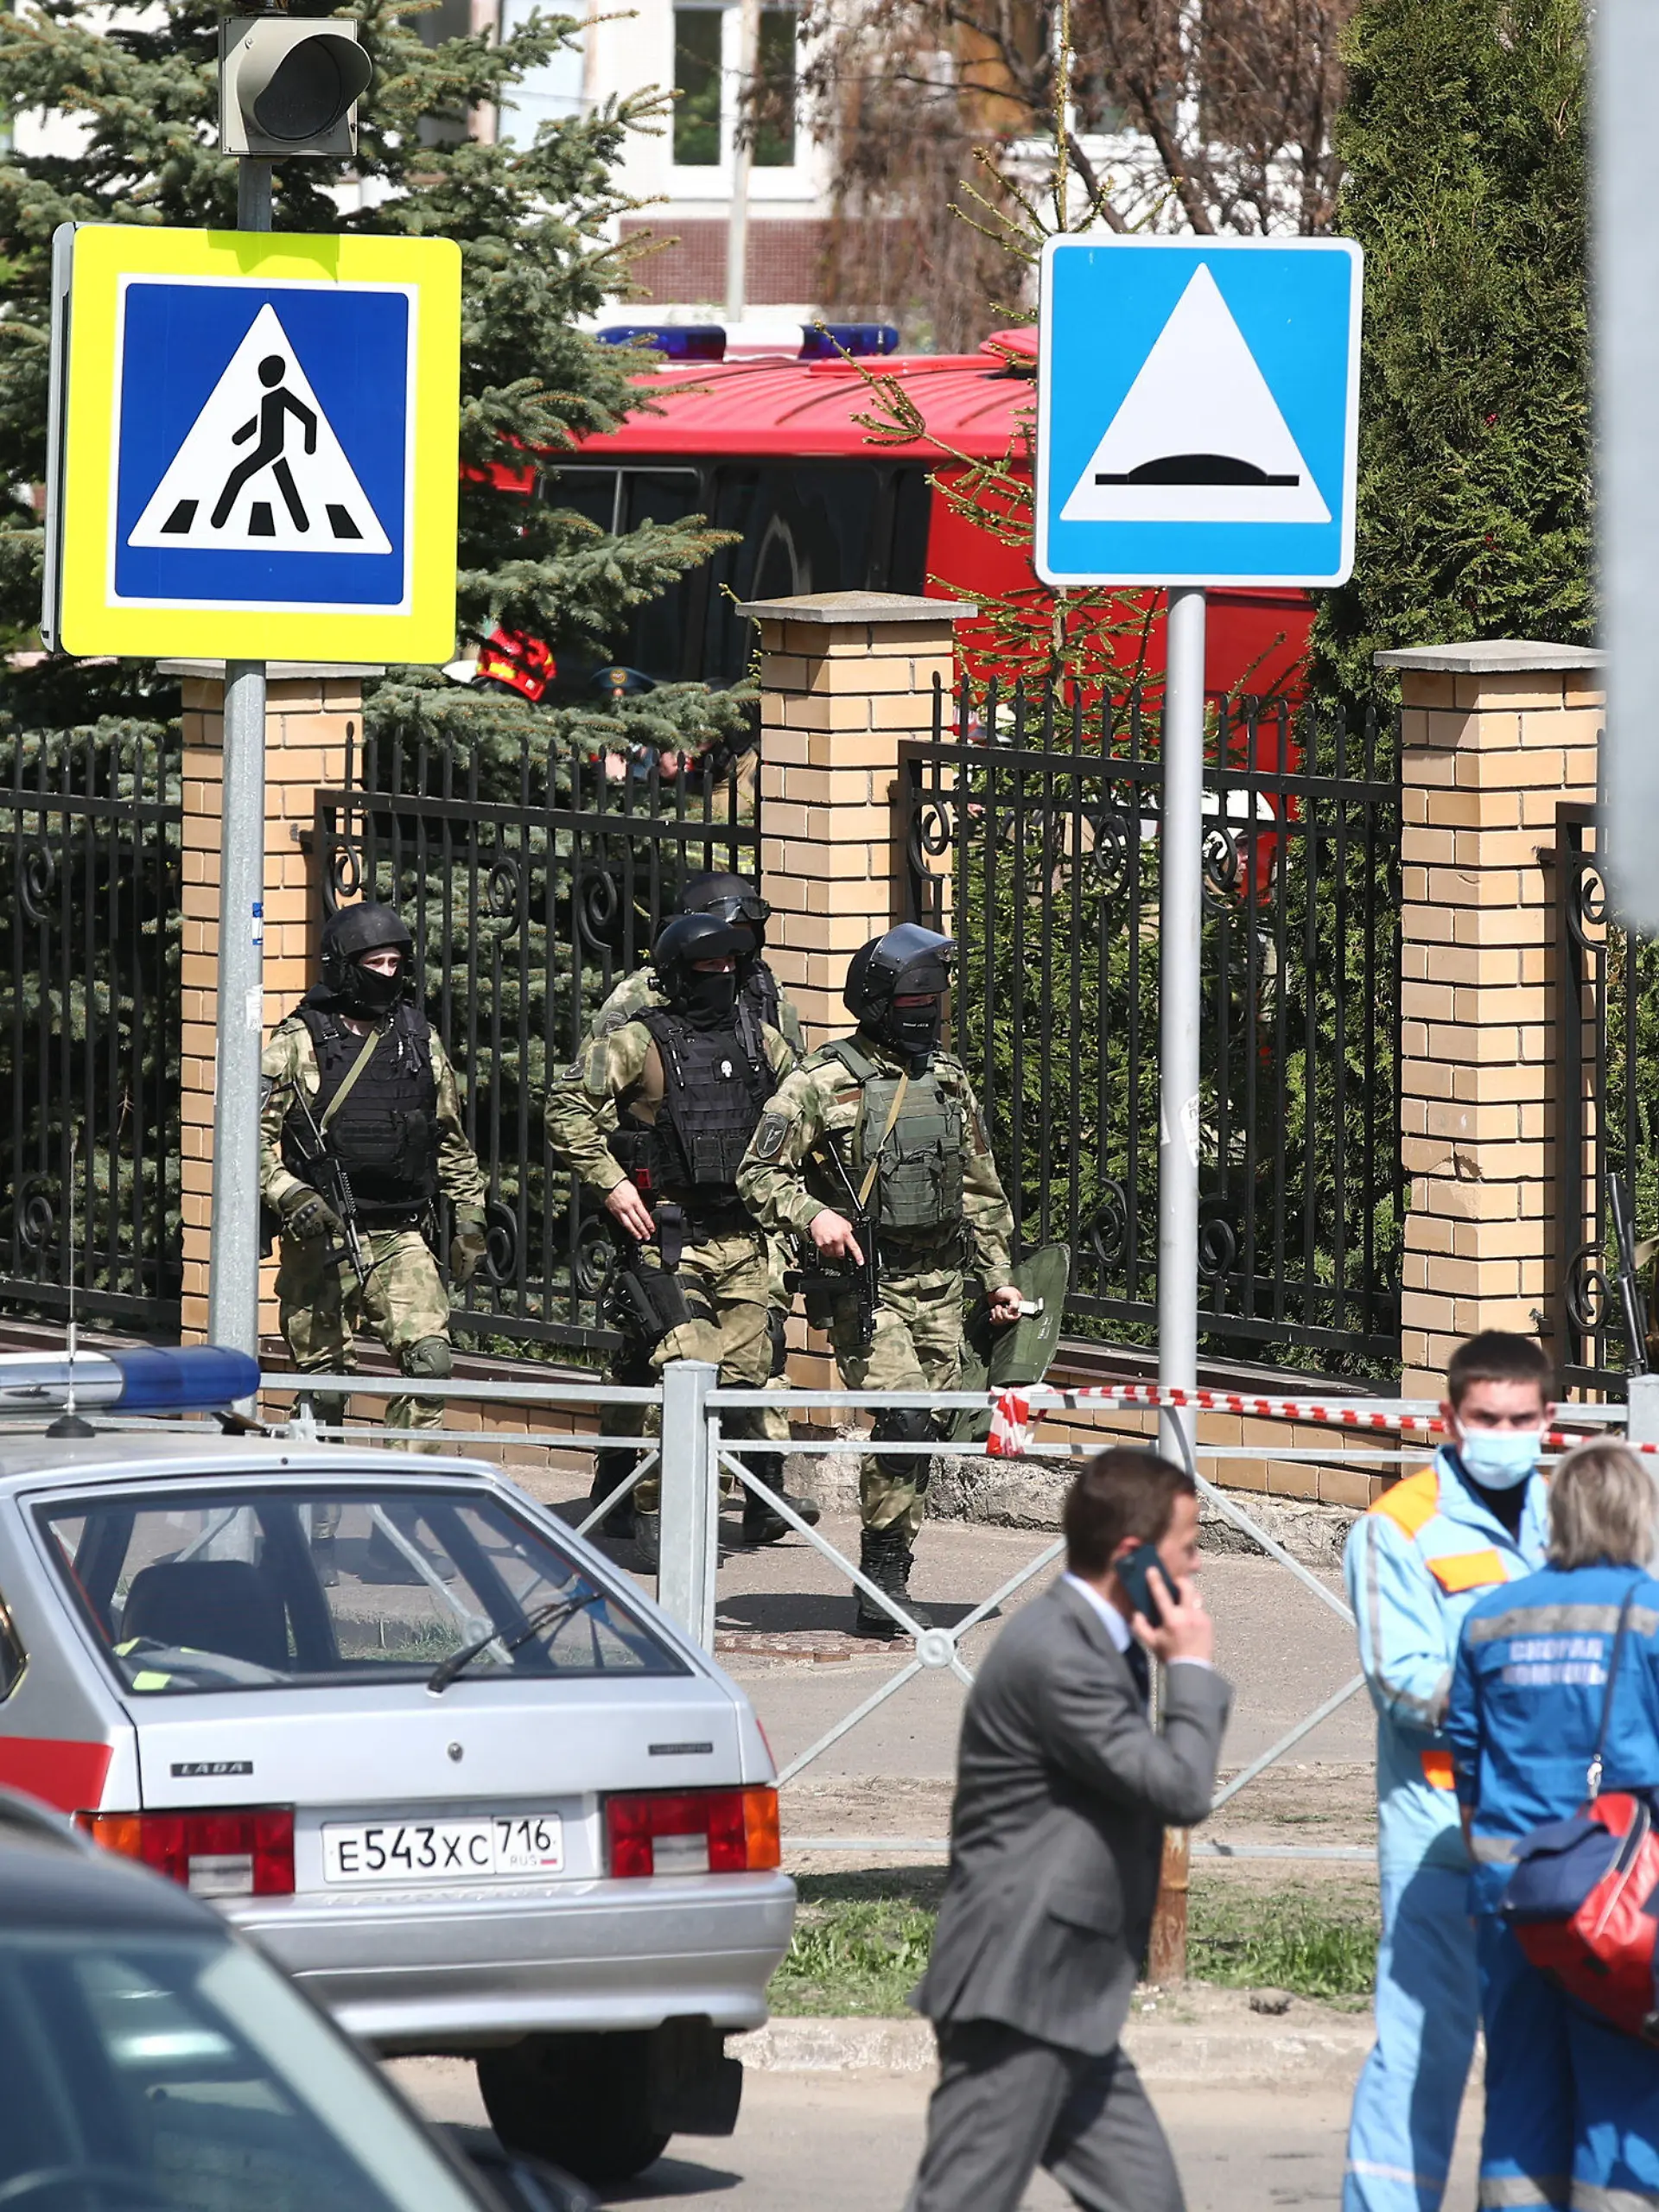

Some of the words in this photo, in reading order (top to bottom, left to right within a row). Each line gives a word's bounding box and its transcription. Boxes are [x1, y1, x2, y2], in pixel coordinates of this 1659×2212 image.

[180, 1763, 243, 1775] LADA
[496, 1818, 551, 1853] 716
[509, 1854, 537, 1867] RUS
